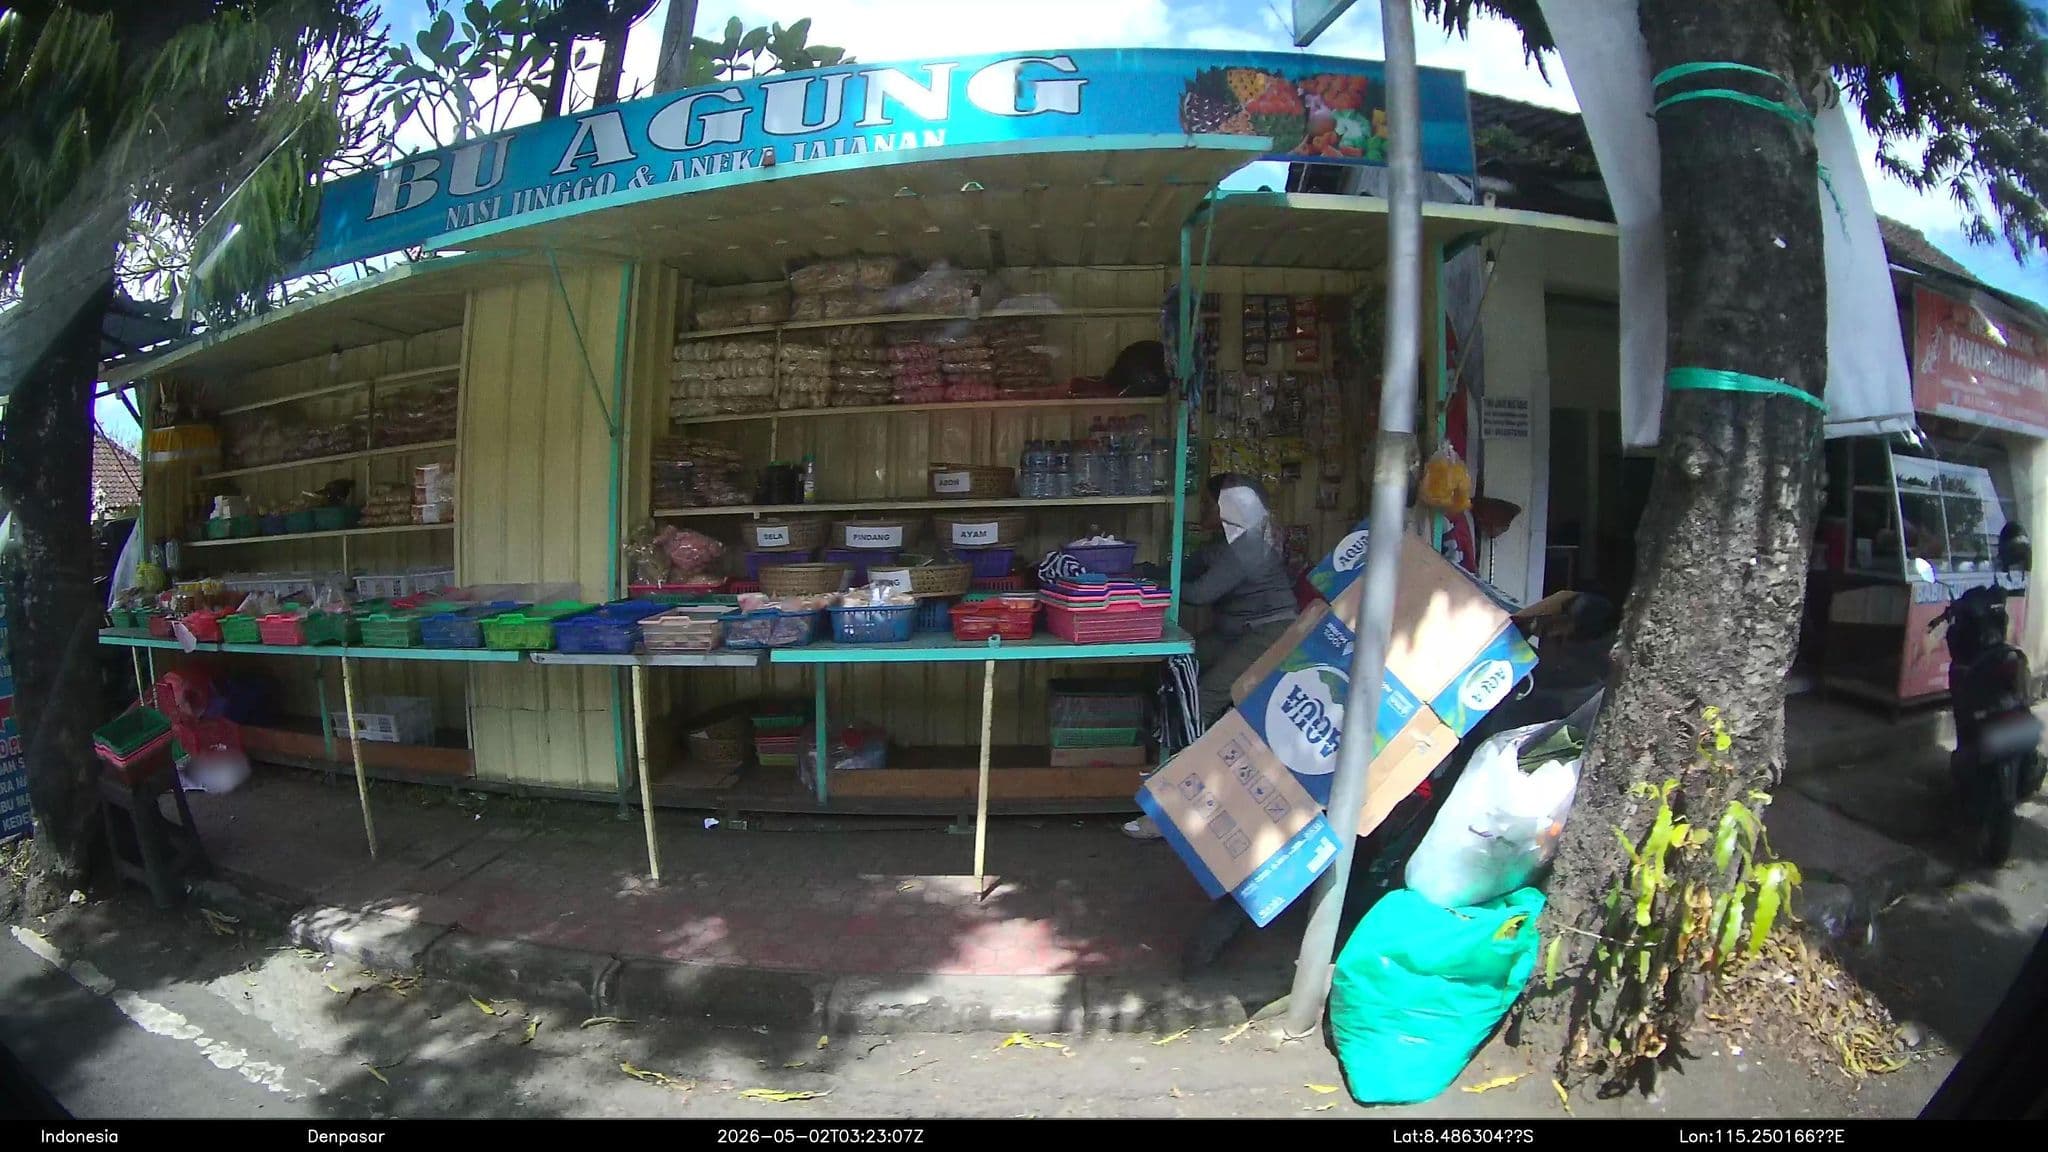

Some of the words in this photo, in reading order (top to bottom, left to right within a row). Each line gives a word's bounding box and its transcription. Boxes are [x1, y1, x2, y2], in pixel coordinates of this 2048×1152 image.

[367, 135, 516, 220] BU
[552, 56, 1088, 175] AGUNG
[445, 196, 502, 231] NASI
[511, 172, 617, 217] JINGGO
[628, 165, 655, 190] &
[669, 146, 775, 181] ANEKA
[852, 533, 891, 542] PINDANG
[960, 530, 988, 539] AYAM
[1281, 684, 1341, 758] AQUA
